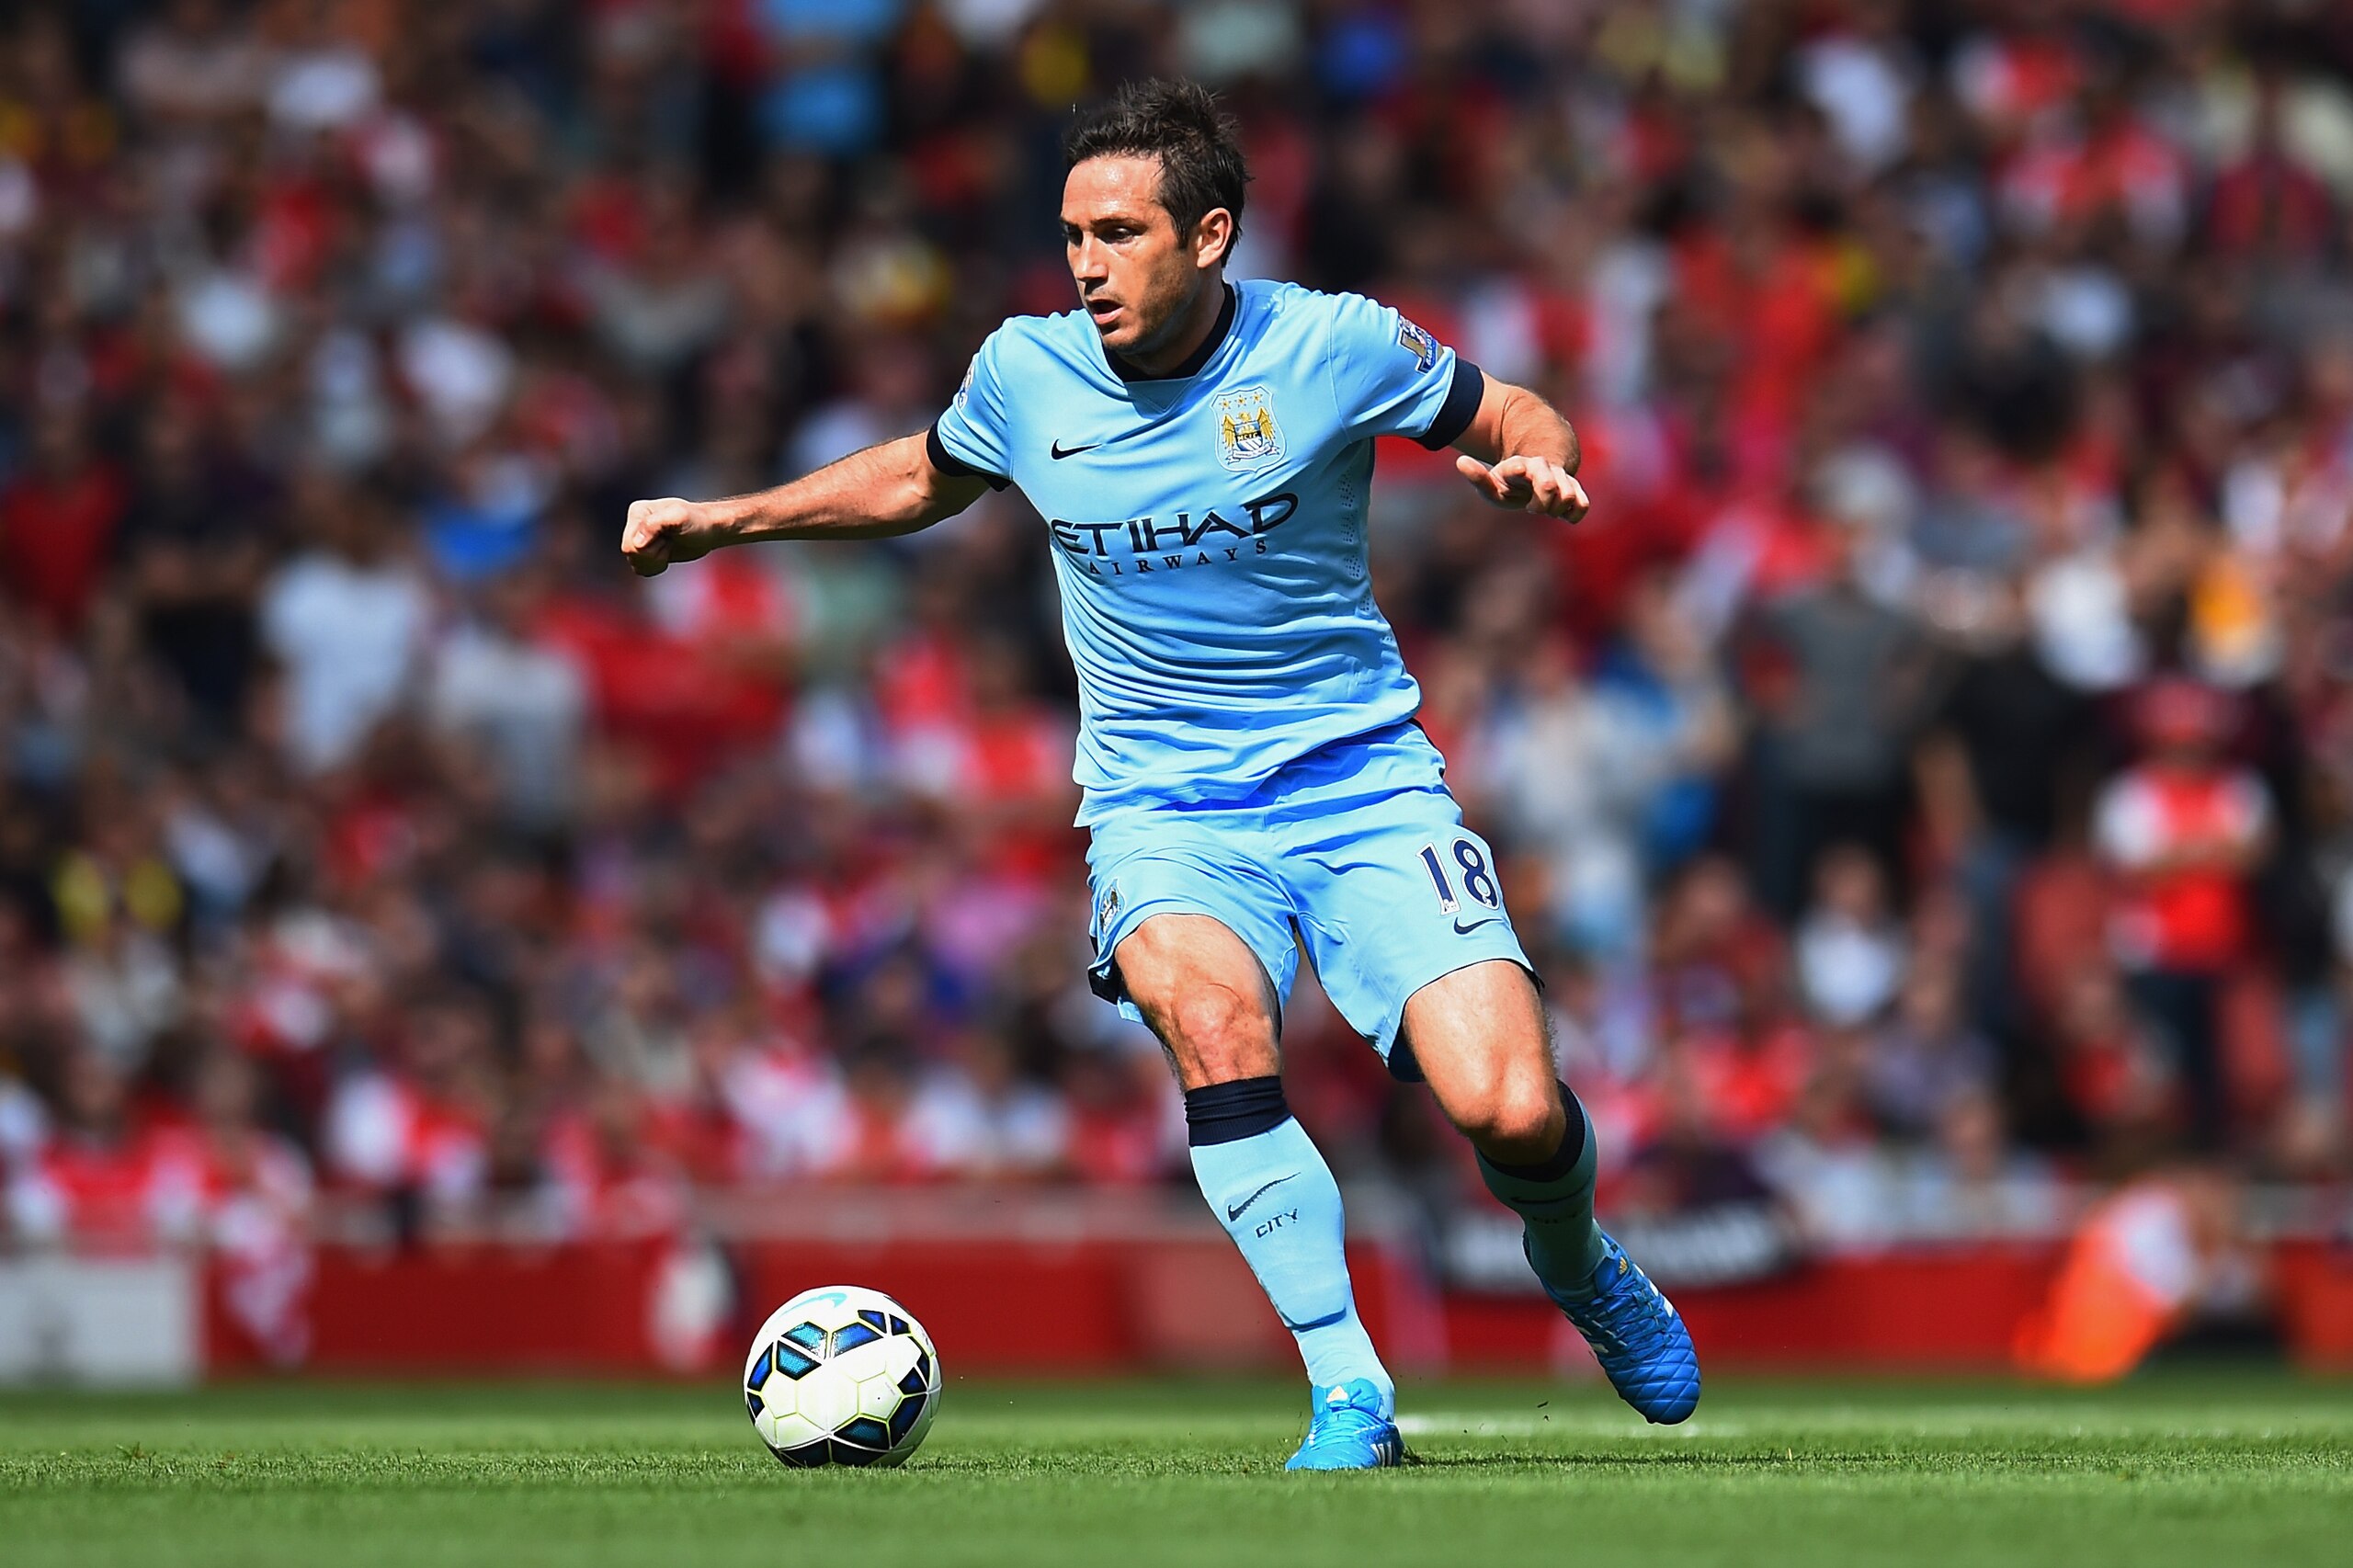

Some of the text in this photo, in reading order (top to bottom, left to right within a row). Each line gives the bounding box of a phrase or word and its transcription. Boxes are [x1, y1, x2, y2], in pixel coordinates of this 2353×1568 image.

[1051, 493, 1299, 556] ETIHAD
[1089, 540, 1267, 575] AIRWAYS
[1416, 839, 1500, 915] 18
[1256, 1209, 1298, 1238] CITY
